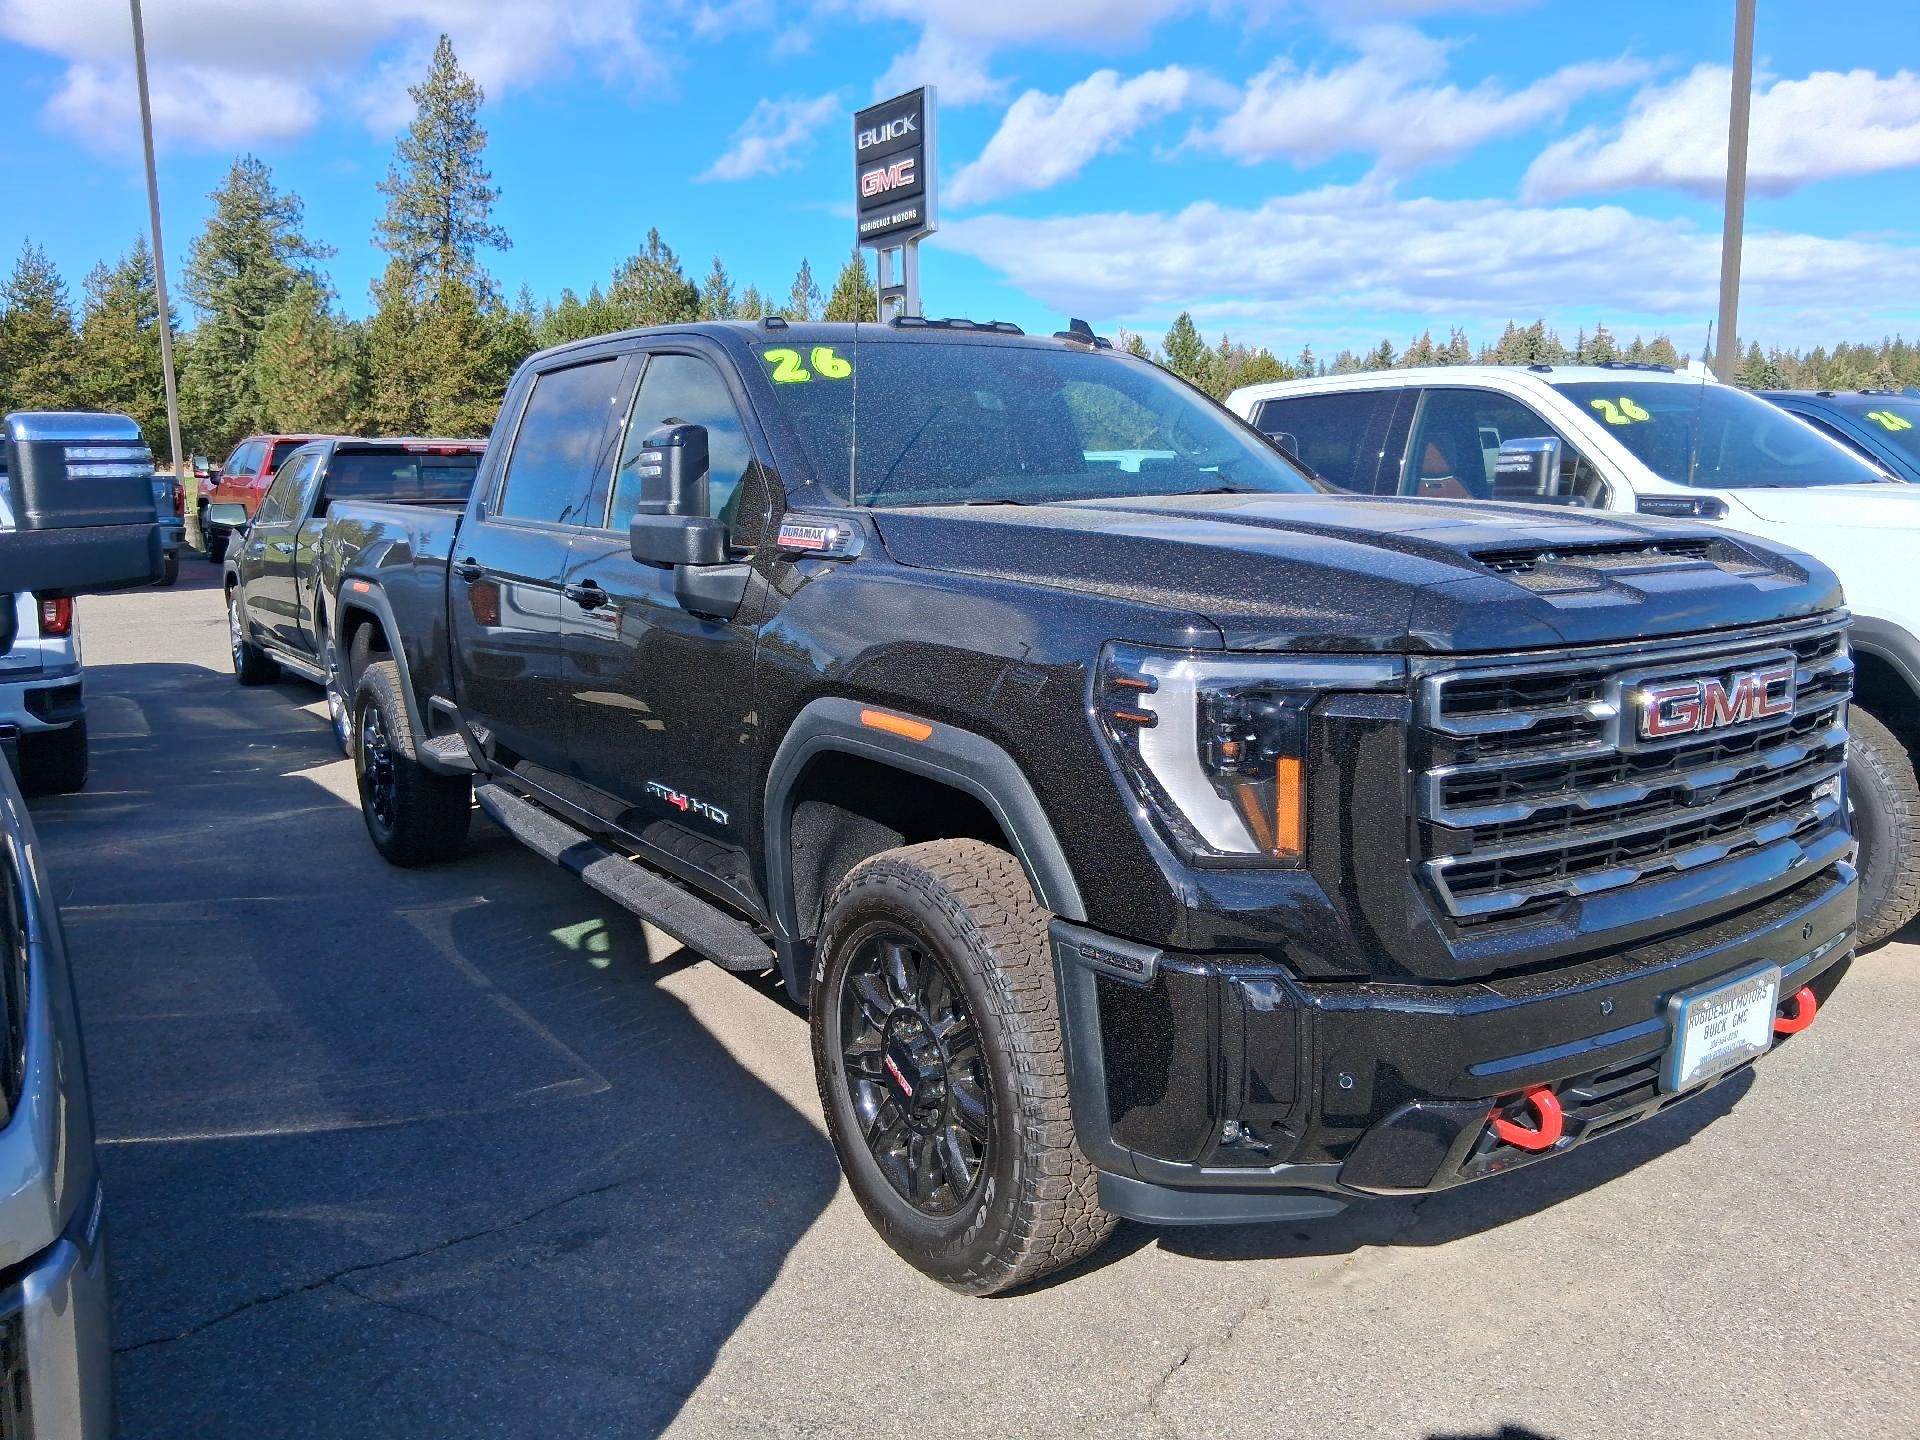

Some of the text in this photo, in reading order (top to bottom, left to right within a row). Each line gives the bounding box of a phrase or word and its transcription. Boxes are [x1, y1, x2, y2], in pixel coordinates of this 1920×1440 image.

[858, 113, 918, 150] BUICK
[861, 158, 915, 198] GMC
[860, 209, 917, 233] ROBIDEAUX MOTORS
[763, 347, 852, 384] 26
[1590, 397, 1650, 425] 26
[782, 527, 824, 540] DURAMAX
[1642, 668, 1794, 738] GMC
[1704, 1017, 1728, 1040] BUICK
[1732, 1009, 1749, 1028] GMC
